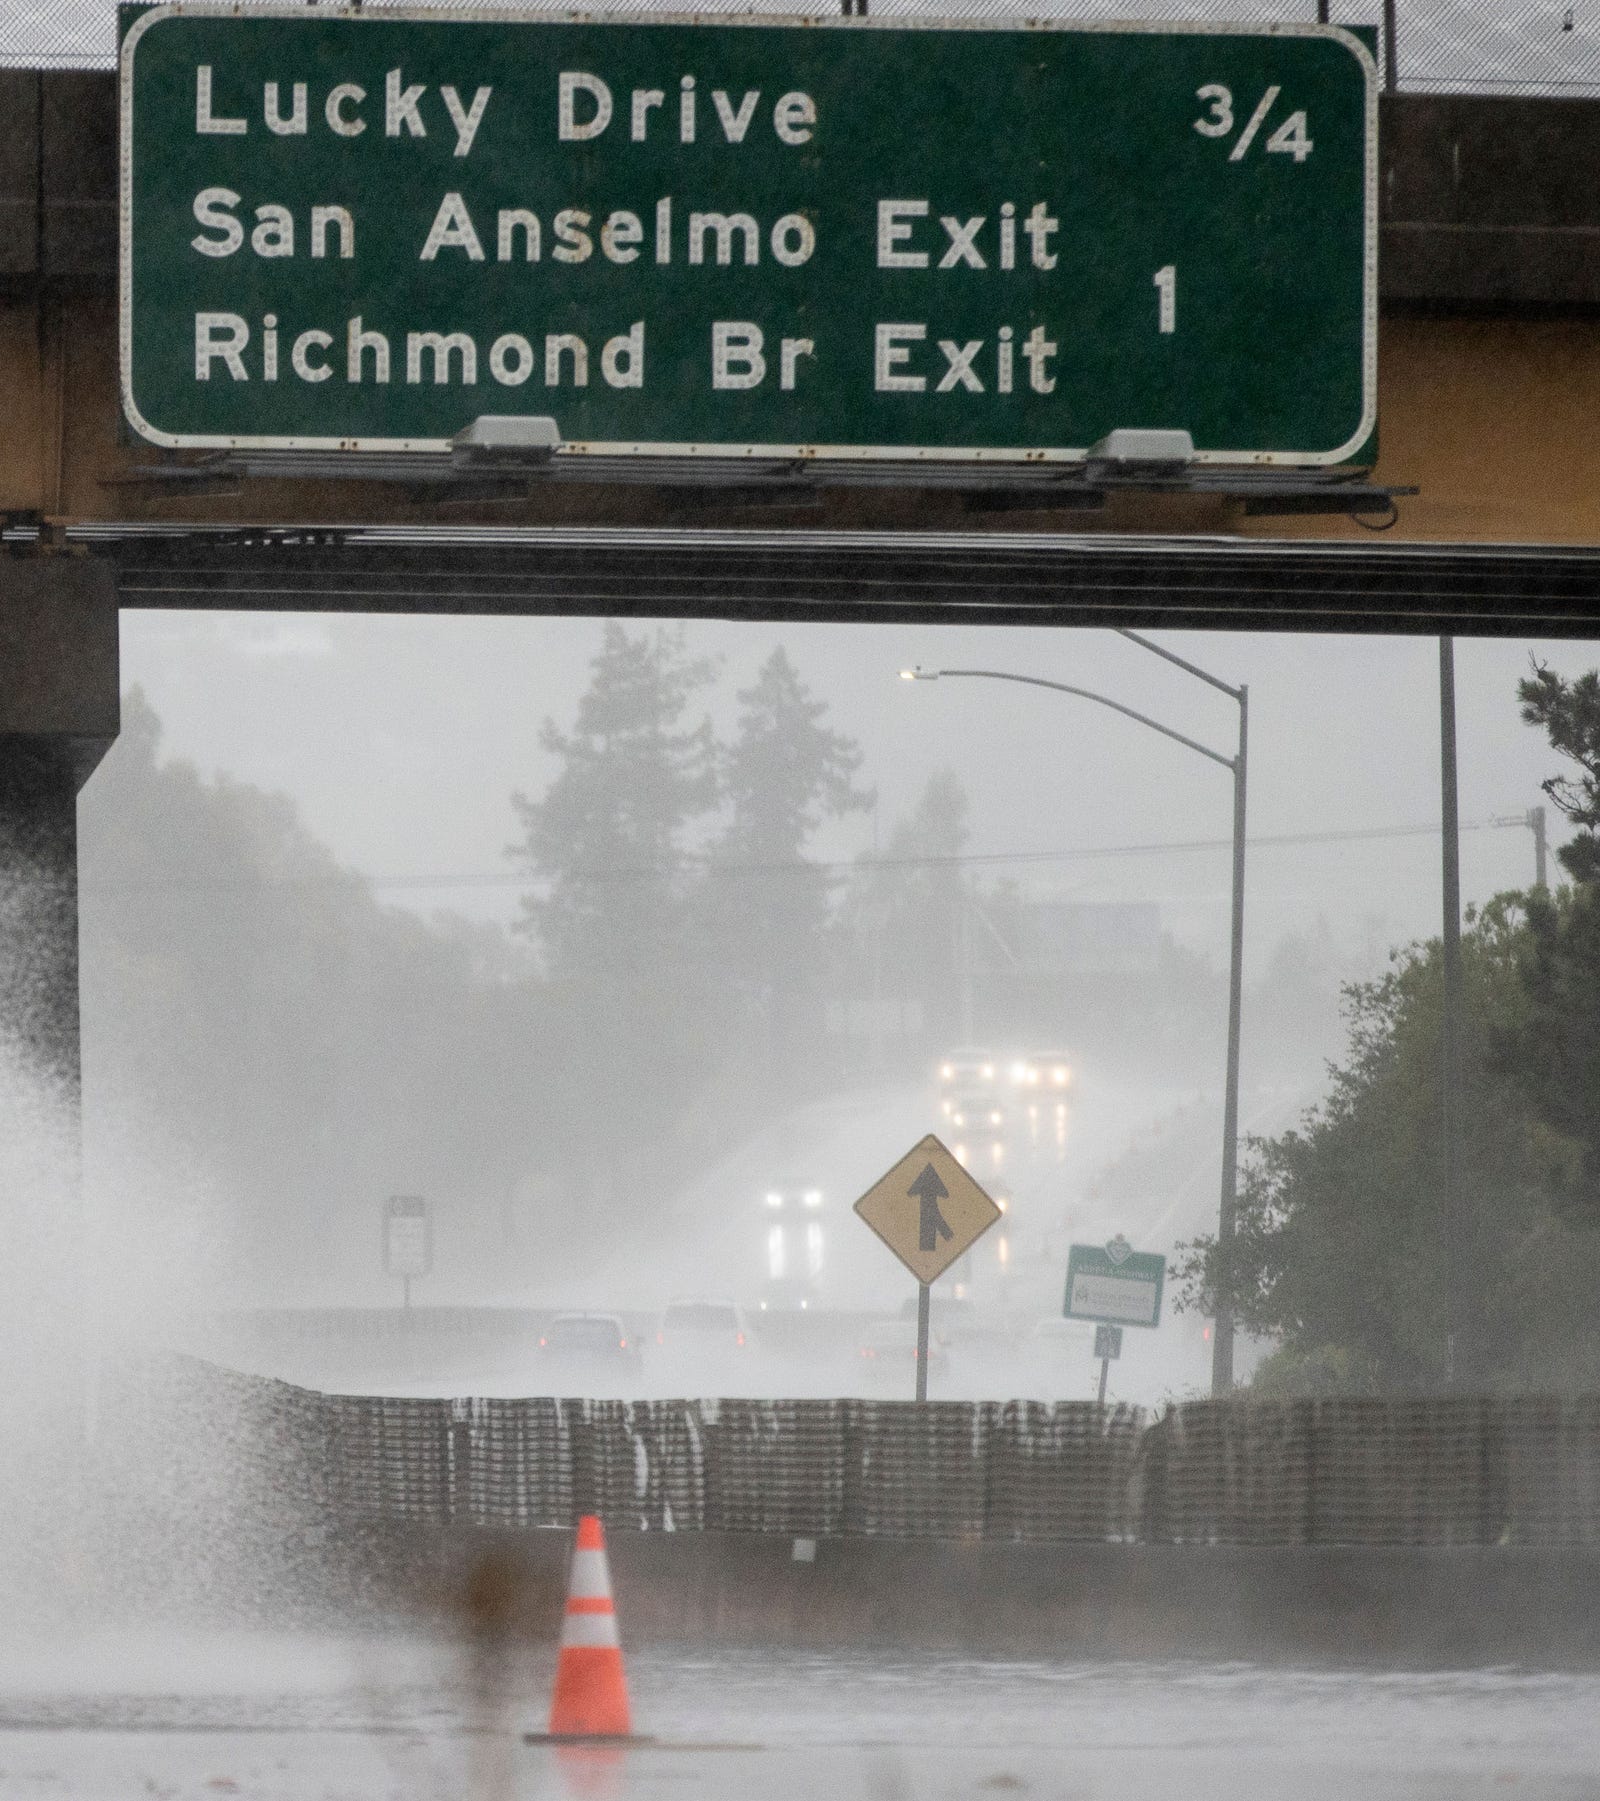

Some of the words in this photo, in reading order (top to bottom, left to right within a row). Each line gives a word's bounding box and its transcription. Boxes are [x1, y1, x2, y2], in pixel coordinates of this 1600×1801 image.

[196, 64, 492, 156] Lucky
[558, 72, 818, 144] Drive
[1194, 83, 1313, 161] 3/4
[190, 187, 354, 258] San
[419, 192, 815, 266] Anselmo
[877, 200, 1059, 270] Exit
[1153, 266, 1175, 333] 1
[195, 312, 644, 388] Richmond
[712, 321, 814, 390] Br
[875, 323, 1057, 393] Exit
